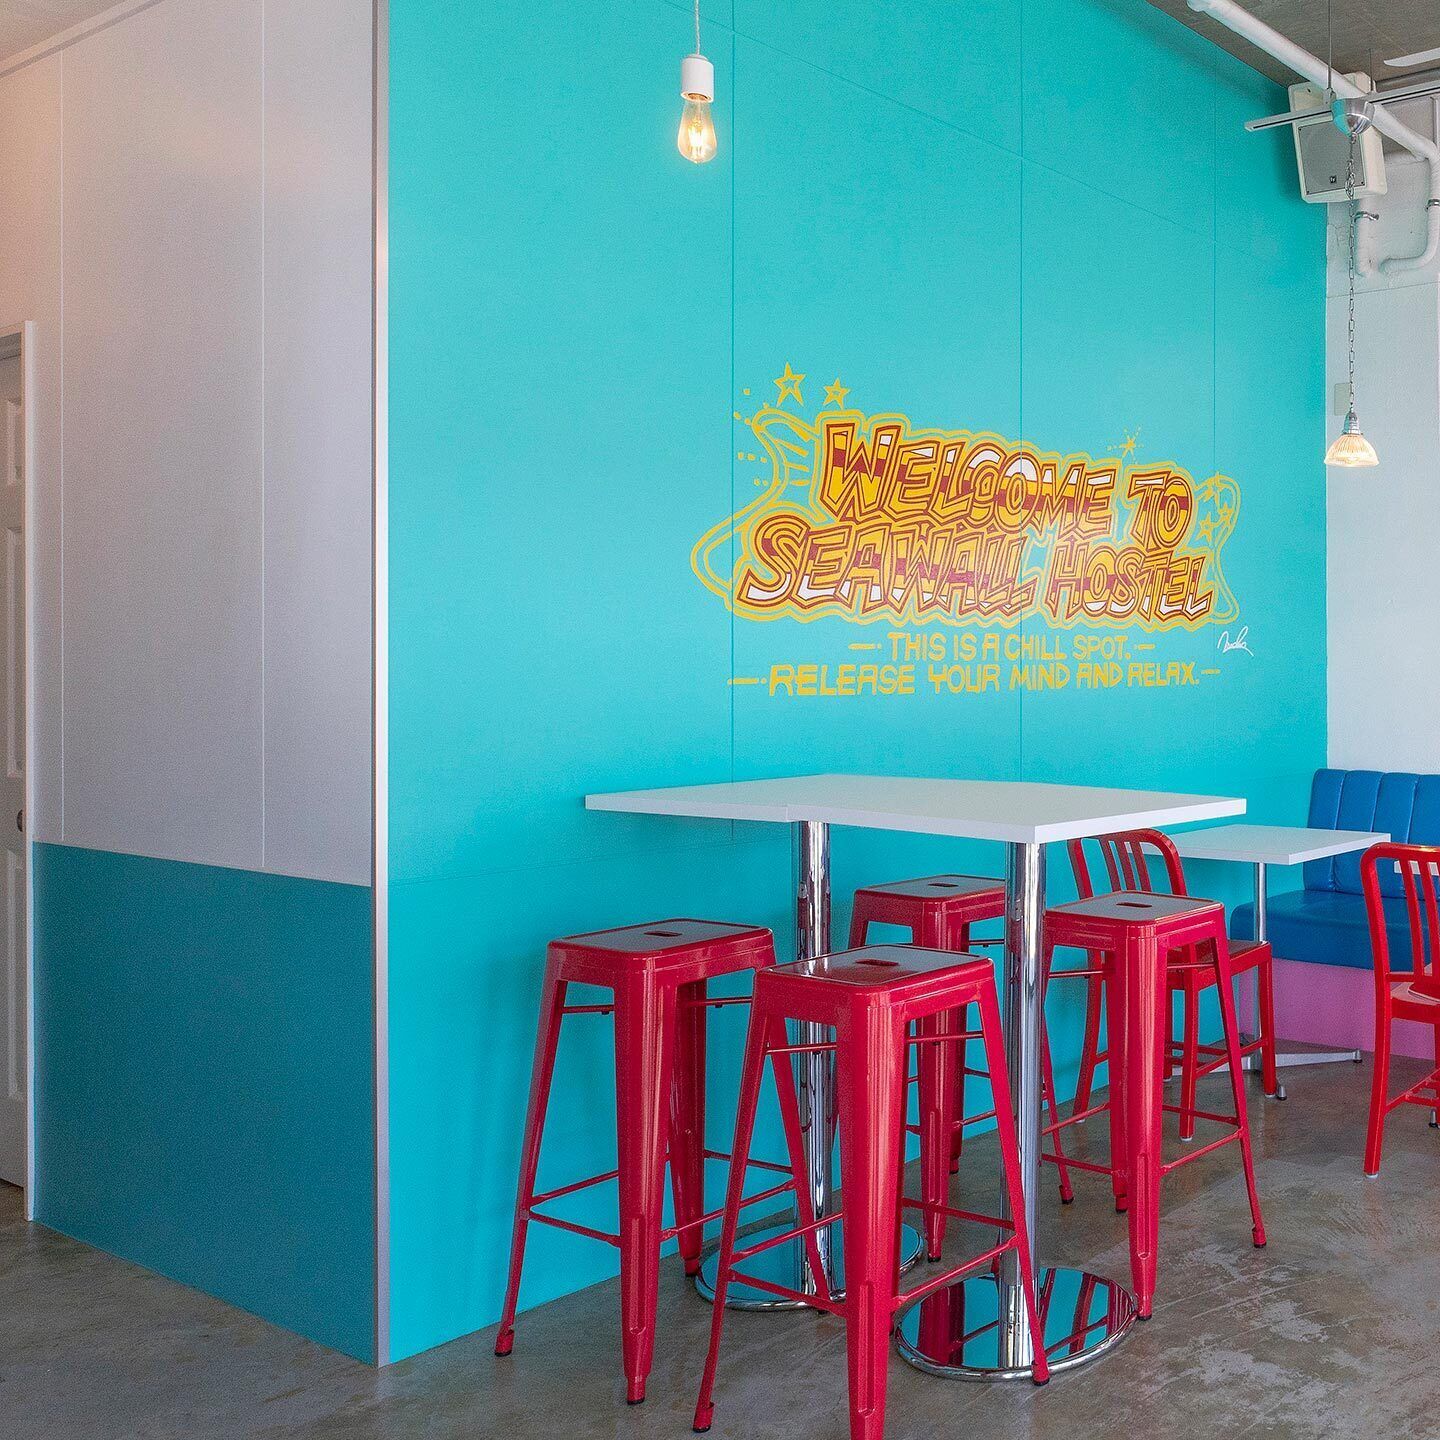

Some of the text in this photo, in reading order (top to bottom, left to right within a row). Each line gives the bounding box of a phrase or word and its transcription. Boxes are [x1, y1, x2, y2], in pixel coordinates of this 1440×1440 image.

[820, 423, 1193, 551] WELCOME TO
[737, 514, 1213, 622] SEAWALL HOSTEL
[769, 661, 1199, 696] RELEASE YOUR MIND AND RELAX.
[887, 632, 1131, 661] THIS IS A CHILL SPOT.
